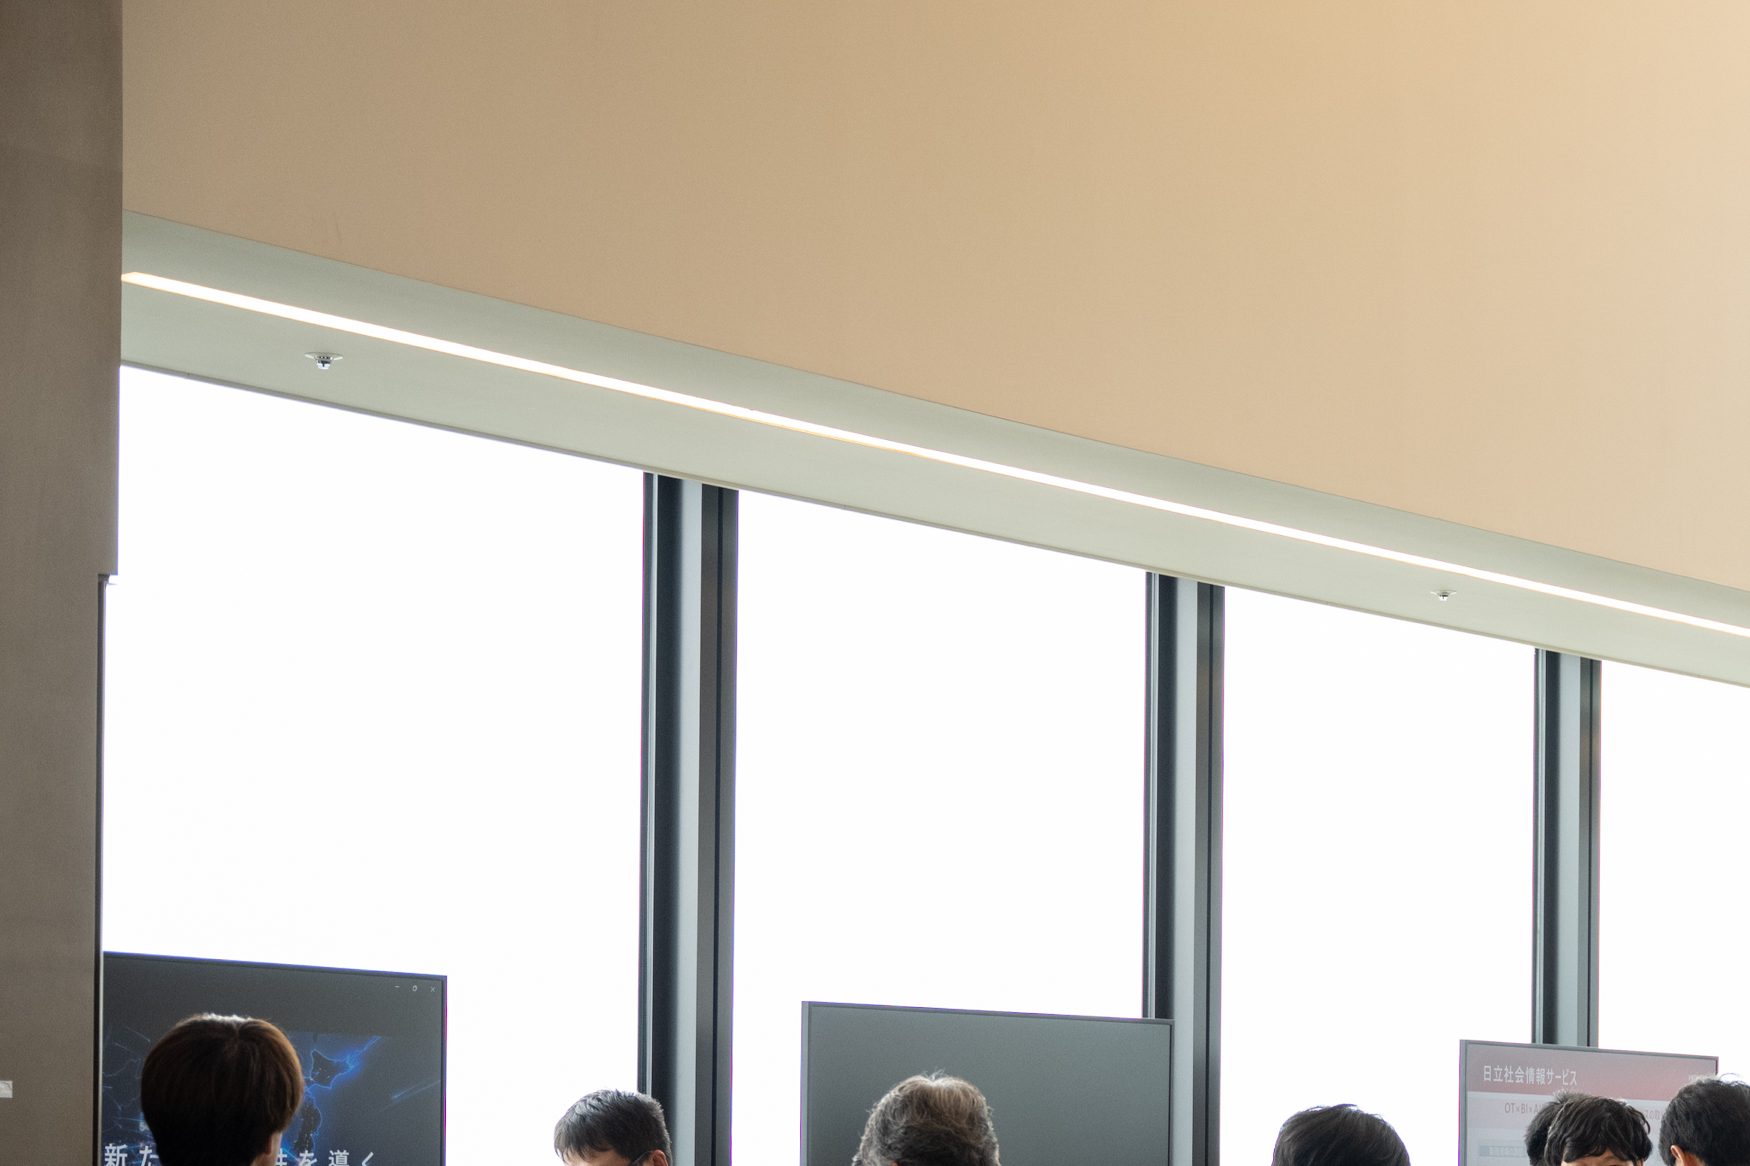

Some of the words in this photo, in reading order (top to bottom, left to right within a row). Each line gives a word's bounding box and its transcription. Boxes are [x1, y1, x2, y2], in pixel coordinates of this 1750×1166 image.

[1483, 1064, 1578, 1087] 日立社会情報サービス
